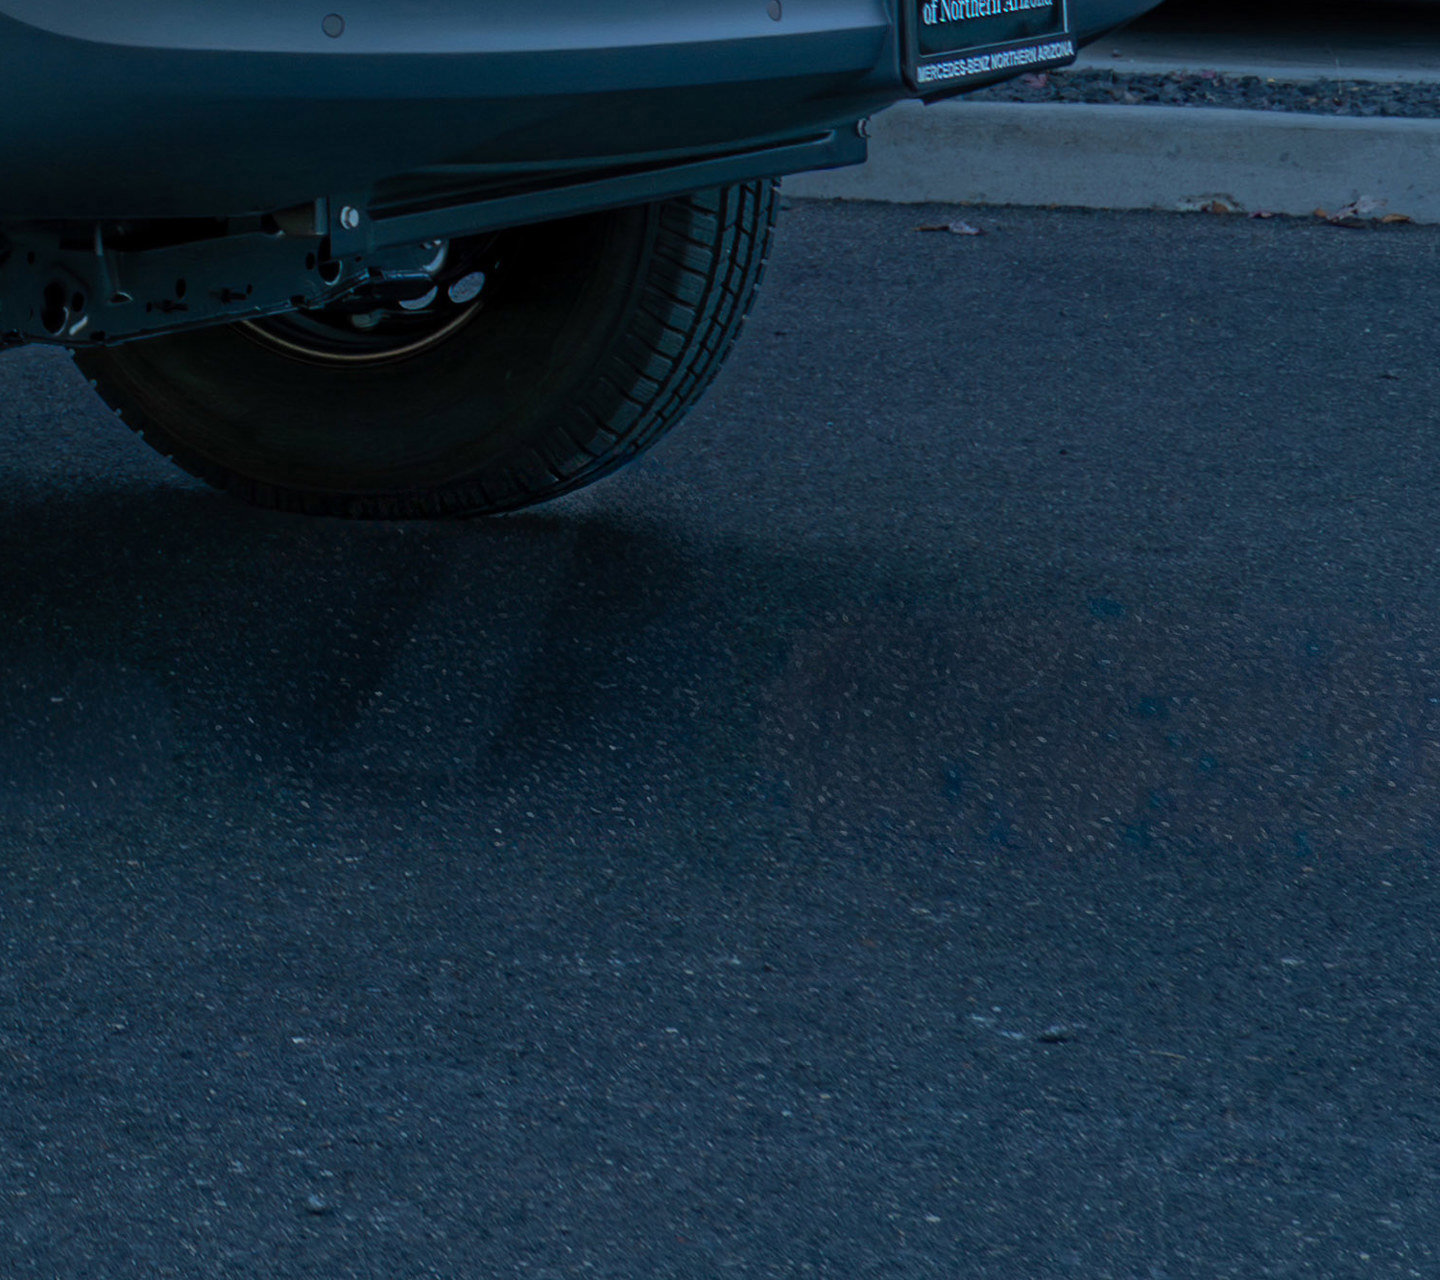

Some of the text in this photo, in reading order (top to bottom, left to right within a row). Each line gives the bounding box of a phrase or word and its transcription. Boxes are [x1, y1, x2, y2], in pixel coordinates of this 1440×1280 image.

[916, 40, 1075, 84] MERCEDES-BENZ NORTHERN ARIZONA
